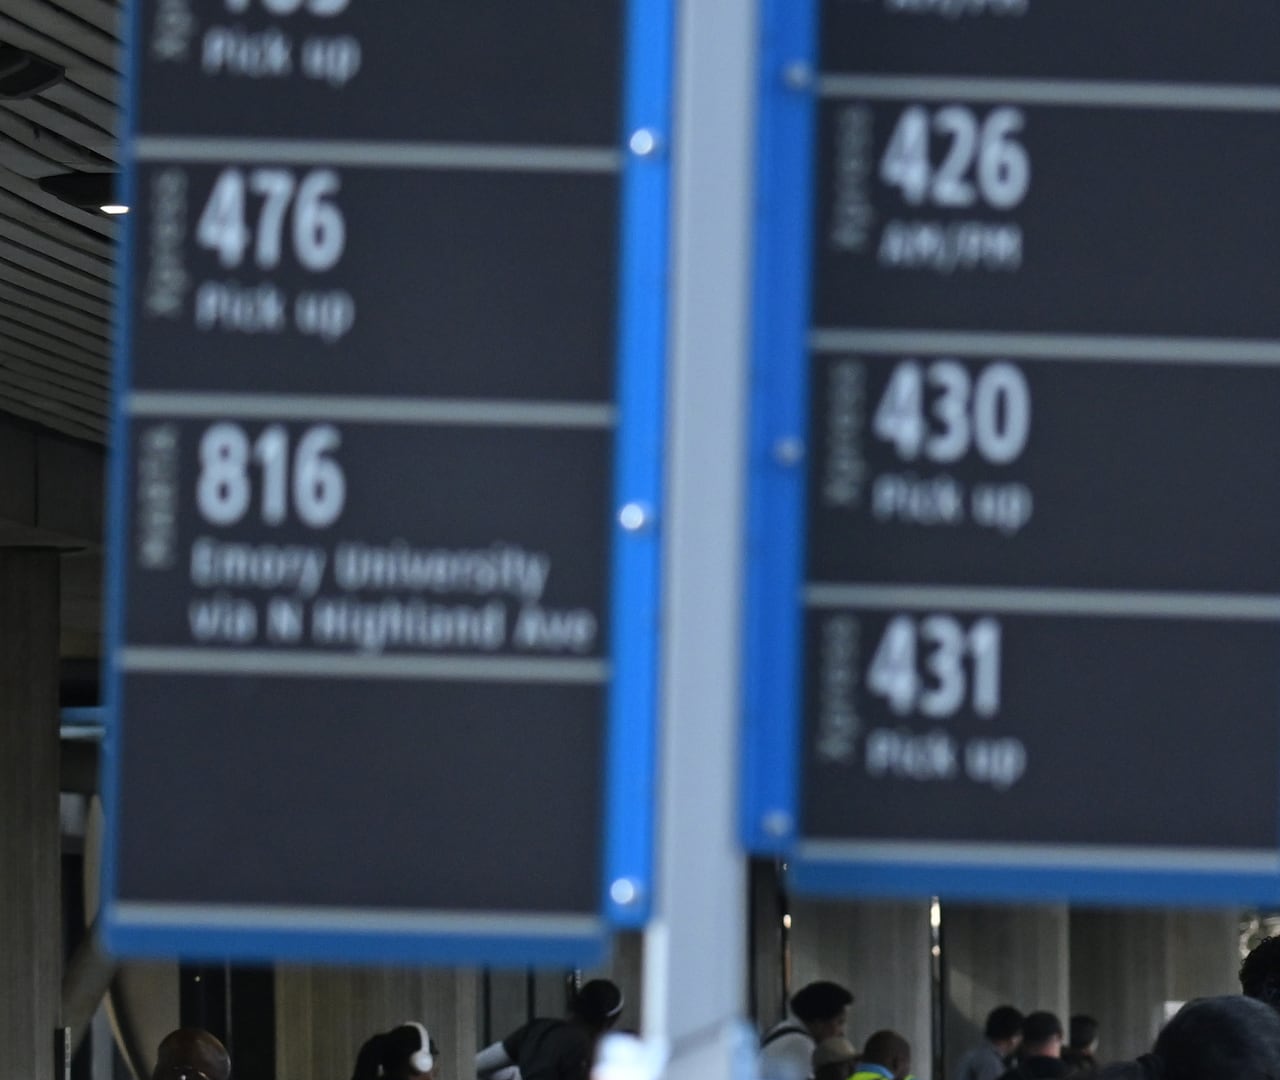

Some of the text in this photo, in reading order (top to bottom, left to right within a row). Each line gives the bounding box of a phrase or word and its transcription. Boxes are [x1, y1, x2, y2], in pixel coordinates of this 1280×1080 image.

[880, 106, 1030, 209] 426
[197, 168, 346, 272] 476
[874, 359, 1031, 465] 430
[197, 422, 346, 528] 816
[868, 614, 999, 719] 431
